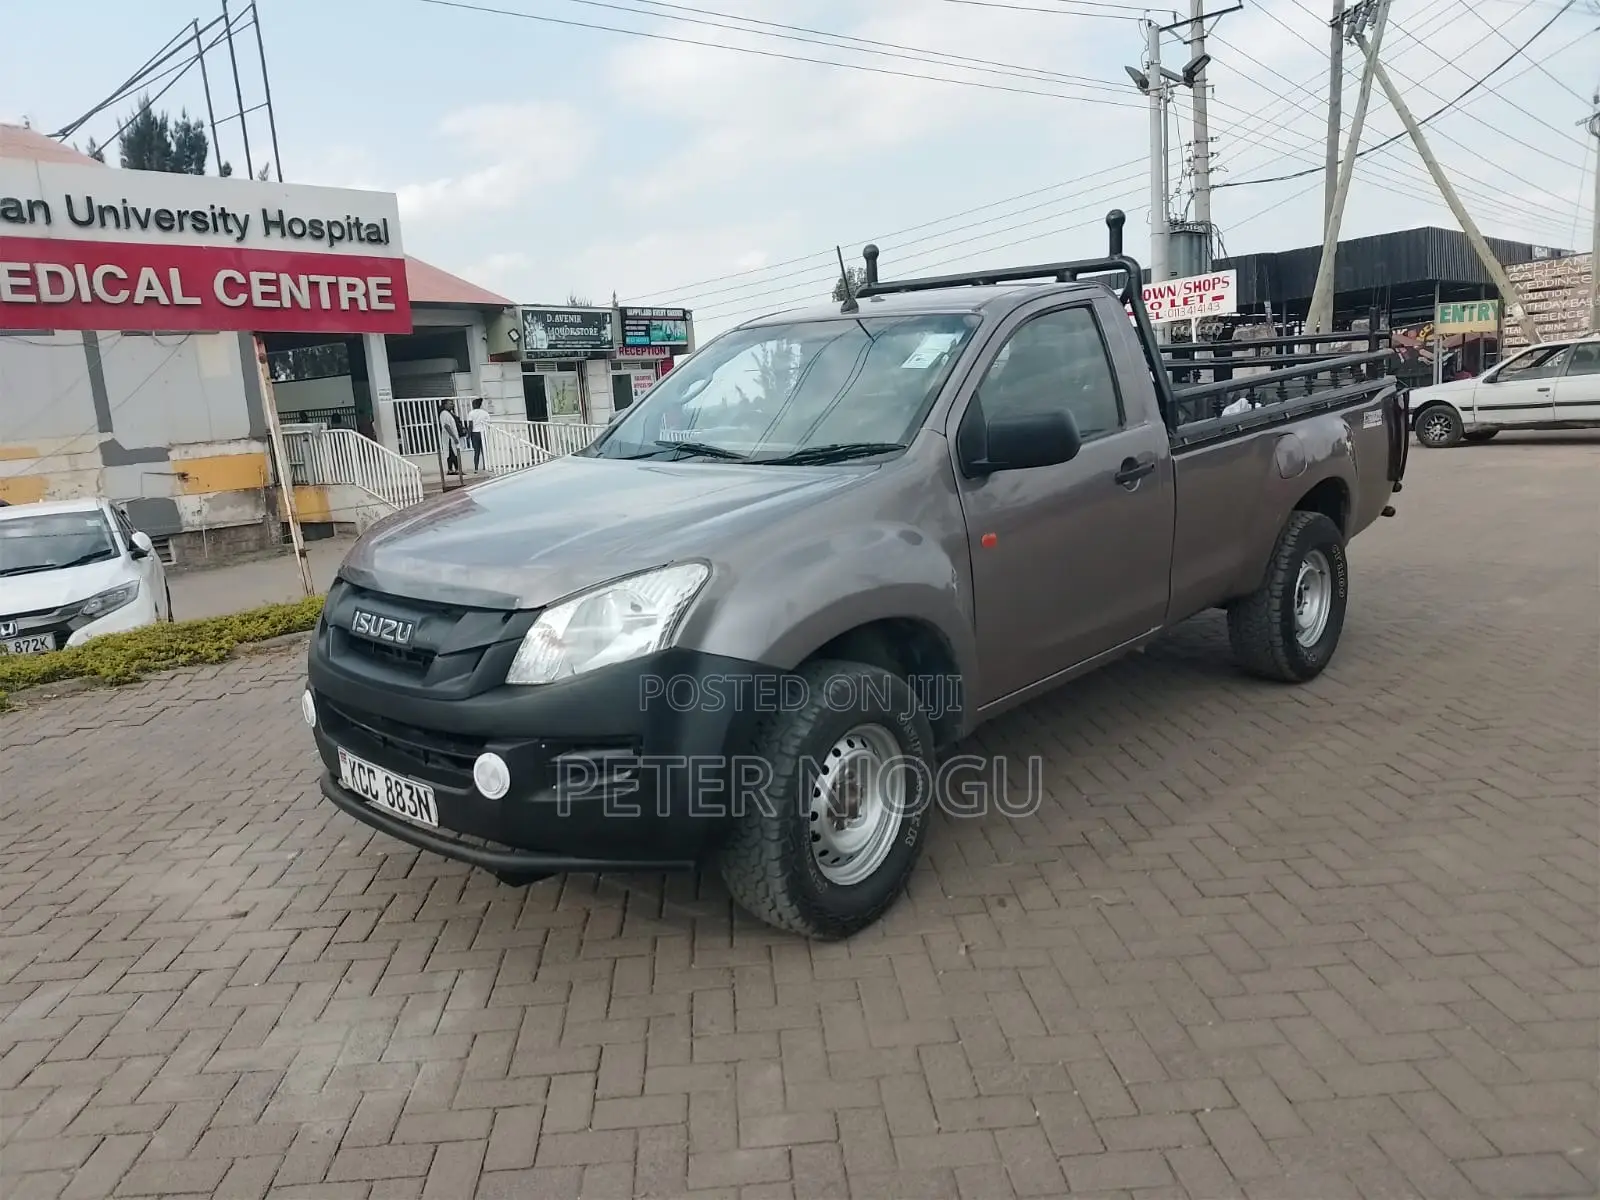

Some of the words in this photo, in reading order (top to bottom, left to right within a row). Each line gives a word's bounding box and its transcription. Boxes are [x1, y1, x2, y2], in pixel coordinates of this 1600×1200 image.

[65, 193, 250, 243] University
[262, 207, 390, 247] Hospital
[0, 261, 202, 305] EDICAL
[213, 268, 396, 311] CENTRE
[1143, 276, 1230, 301] OWN/SHOPS
[1171, 294, 1207, 308] LET
[1440, 302, 1498, 323] ENTRY
[618, 346, 666, 356] RECEPTION
[352, 610, 413, 645] ISUZU
[14, 636, 50, 653] 872K
[348, 757, 379, 801] KCC
[384, 775, 433, 823] 883N
